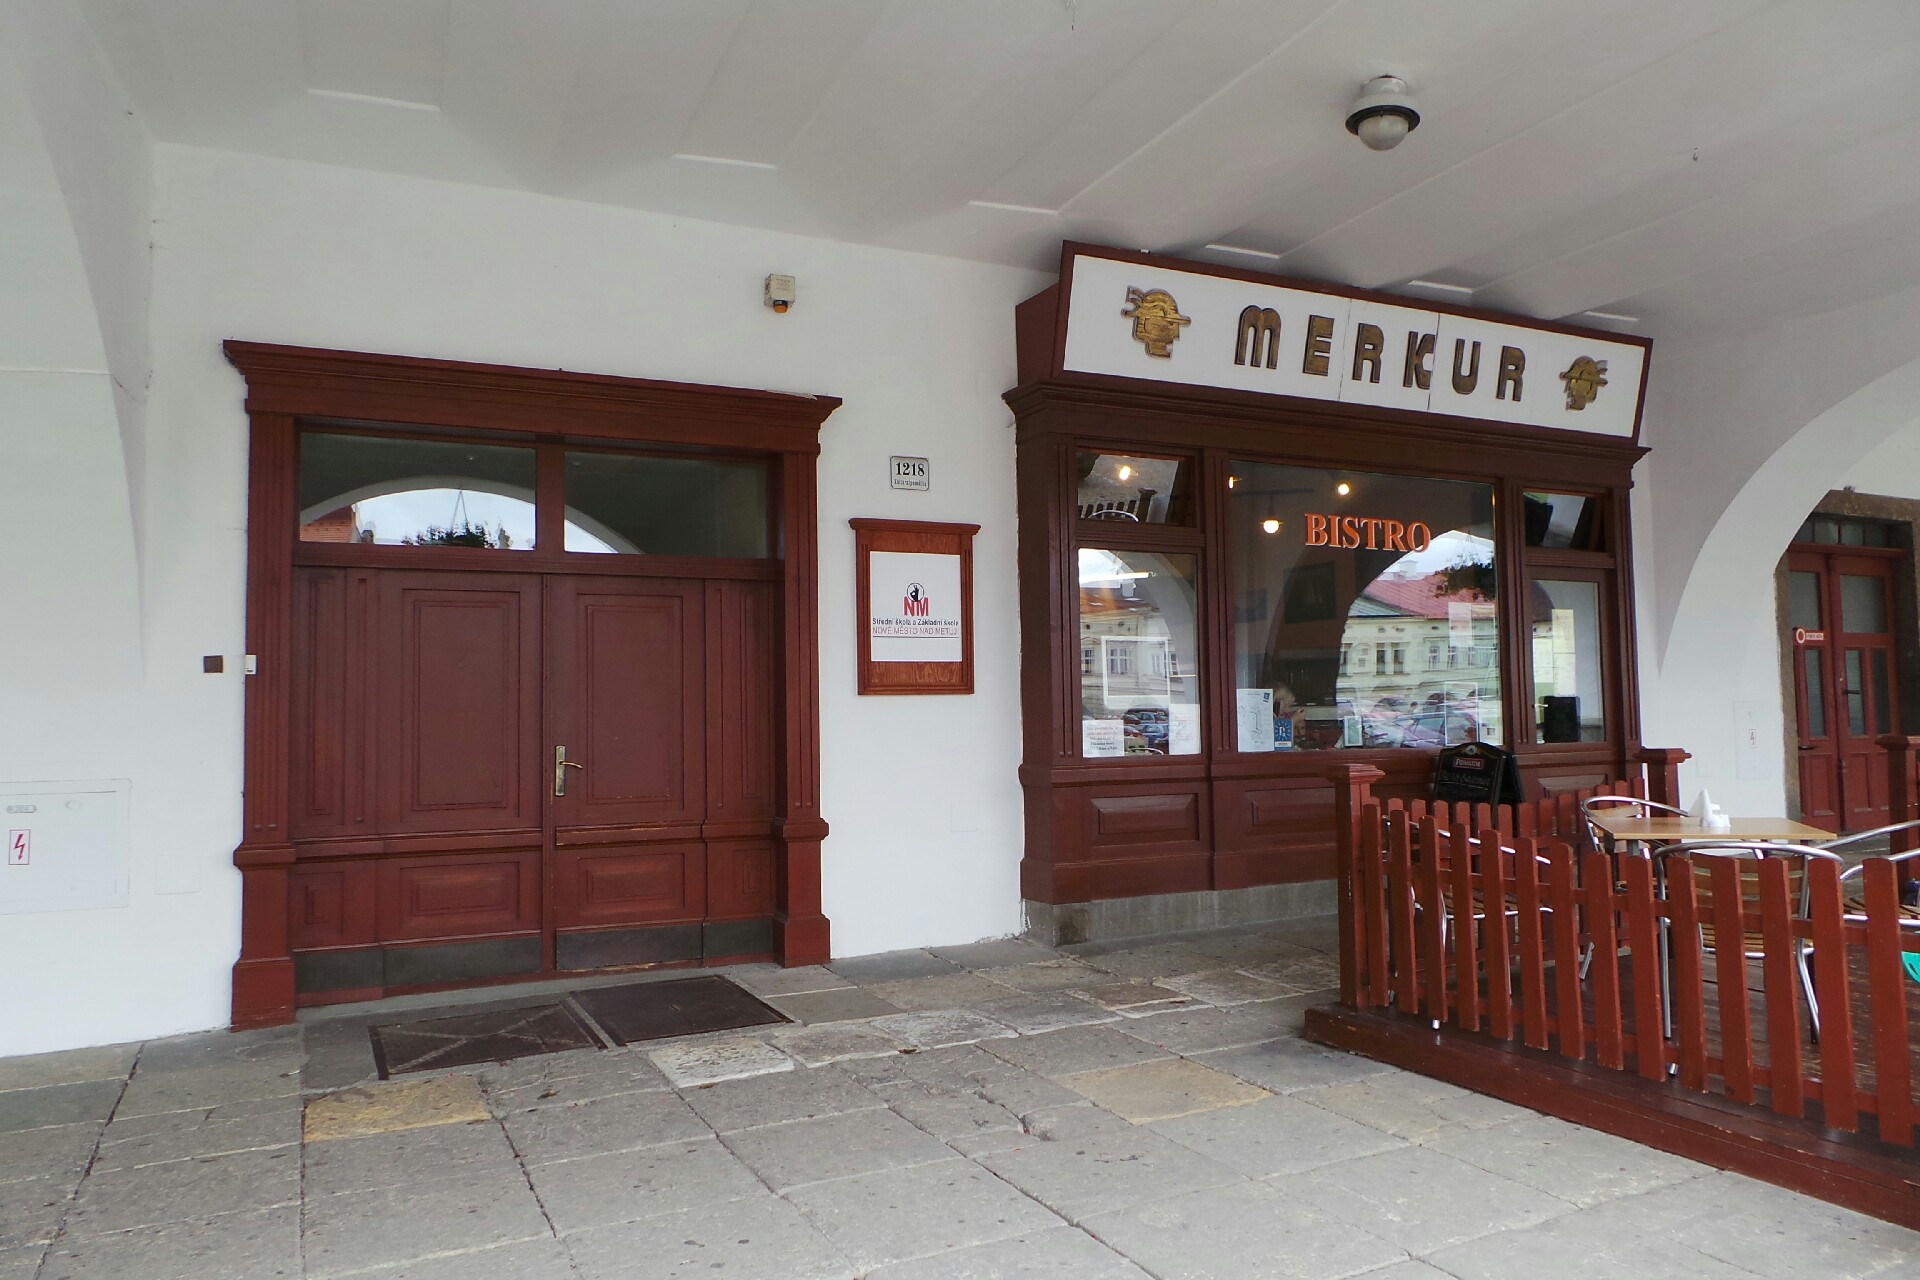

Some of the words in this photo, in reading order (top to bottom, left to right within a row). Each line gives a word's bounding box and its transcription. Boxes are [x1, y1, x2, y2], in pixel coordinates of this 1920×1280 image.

[1233, 304, 1527, 402] MERKUR
[896, 461, 925, 477] 1218
[1304, 512, 1431, 553] BISTRO
[903, 596, 929, 617] NM
[872, 624, 892, 635] NOVÉ
[893, 625, 918, 635] MĚSTO
[919, 627, 934, 635] NAD
[895, 618, 911, 626] škola
